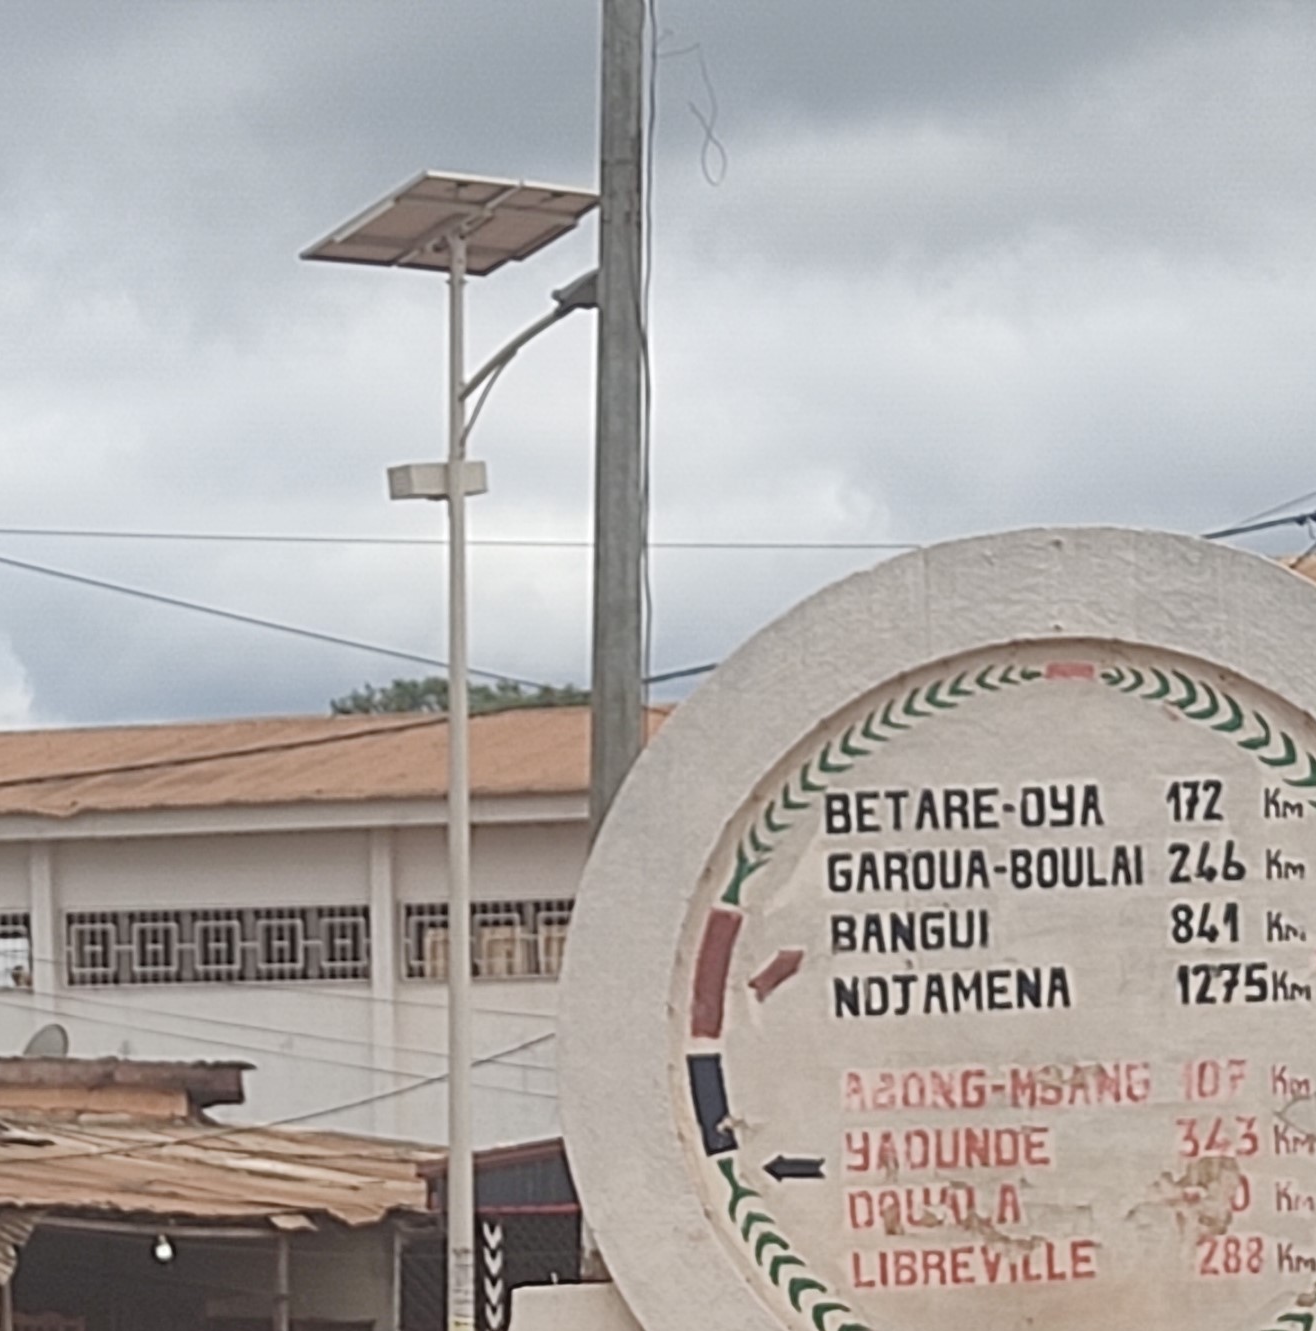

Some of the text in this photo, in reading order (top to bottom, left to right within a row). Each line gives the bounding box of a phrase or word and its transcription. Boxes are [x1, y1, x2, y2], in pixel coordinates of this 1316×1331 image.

[824, 779, 1304, 834] BETARE-OYA 172 Km
[827, 840, 1305, 893] GAROUA-BOULAI 246 Km
[831, 902, 1307, 954] BANGUI 841 Km
[834, 967, 1071, 1018] NDJAMENA
[1272, 1065, 1311, 1096] Km
[845, 1117, 1316, 1172] YAOUNDE 343 Km
[1275, 1182, 1316, 1212] Km
[852, 1240, 1097, 1288] LIBREVILLE
[1196, 1237, 1264, 1275] 288
